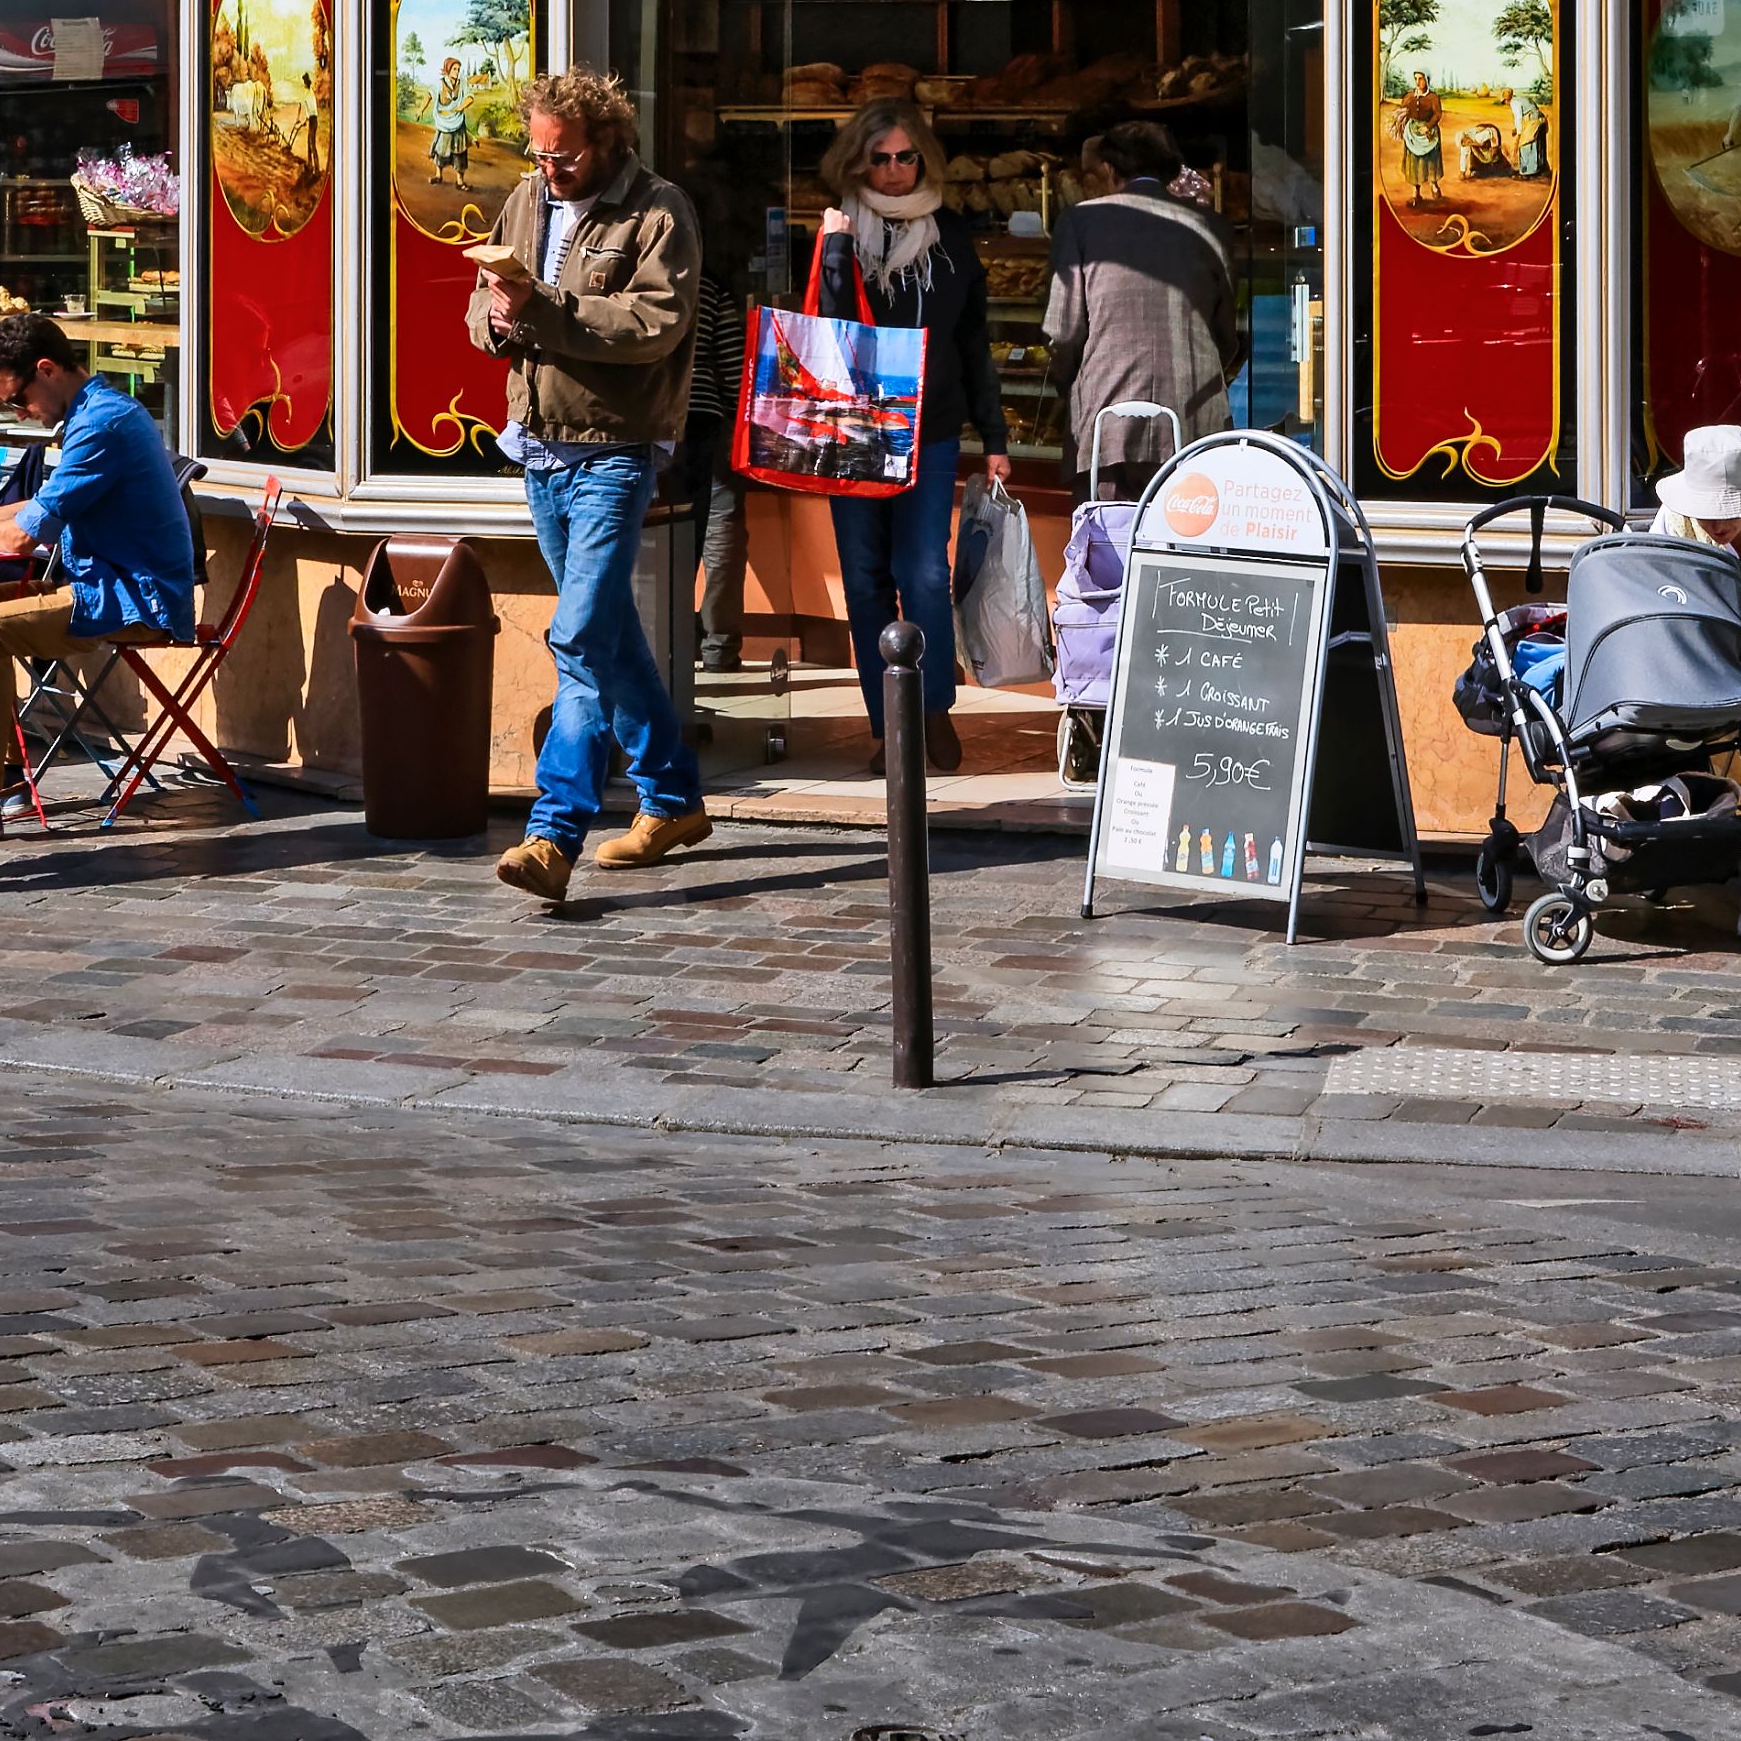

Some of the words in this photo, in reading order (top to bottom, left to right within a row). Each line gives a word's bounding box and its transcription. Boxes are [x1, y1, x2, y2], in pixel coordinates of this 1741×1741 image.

[1224, 479, 1302, 502] Partagez
[1222, 503, 1240, 517] un
[1244, 505, 1312, 523] moment
[1220, 522, 1240, 538] de
[1245, 521, 1298, 541] Plaisir
[1160, 577, 1242, 613] FORMULE
[1175, 647, 1192, 665] 1
[1200, 652, 1243, 669] CAFÉ
[1176, 679, 1192, 697] 1
[1166, 708, 1182, 726] 1
[1183, 711, 1212, 728] JUS
[1185, 753, 1271, 791] 5,90€
[1116, 798, 1136, 806] Orange
[1133, 828, 1157, 837] chocolat
